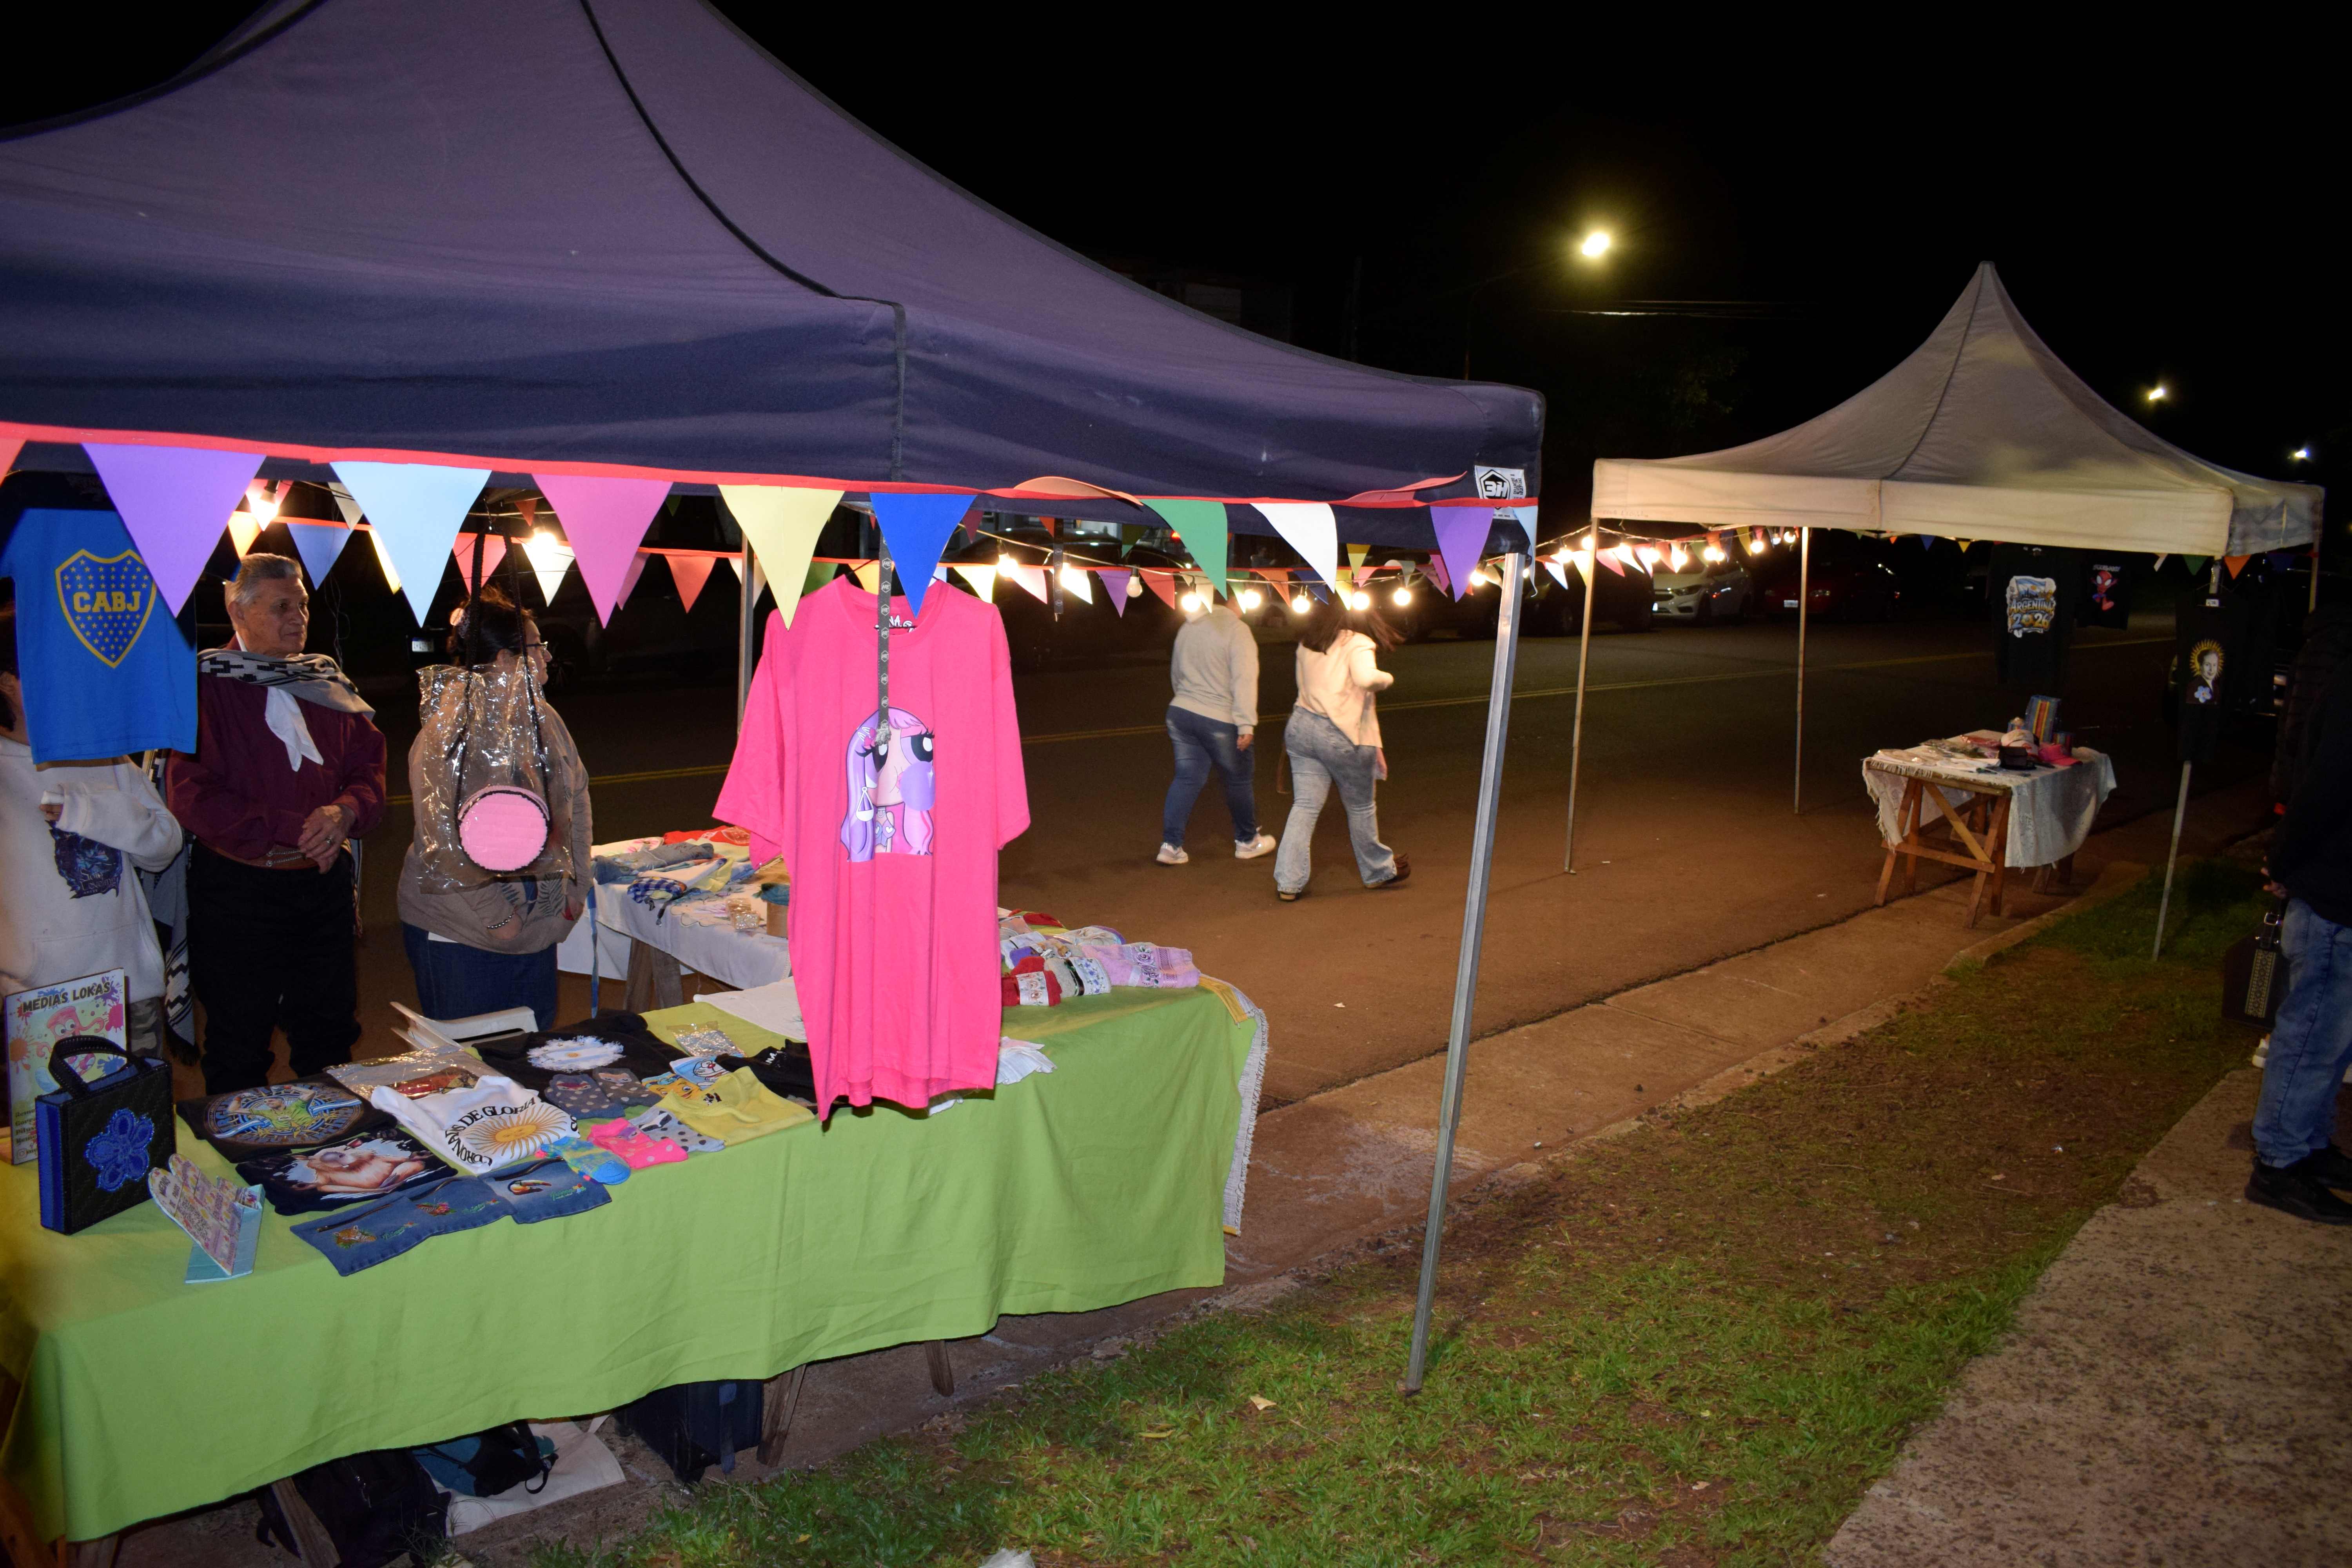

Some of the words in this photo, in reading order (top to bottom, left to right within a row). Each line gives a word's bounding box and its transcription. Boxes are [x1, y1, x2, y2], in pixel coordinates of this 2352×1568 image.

[1485, 481, 1508, 497] 3H
[73, 591, 141, 613] CABJ
[2011, 599, 2053, 612] ARGENTINA
[22, 992, 69, 1013] MEDIAS
[72, 982, 111, 1001] LOKAS
[458, 1110, 484, 1127] DE
[482, 1097, 536, 1116] GLORIA
